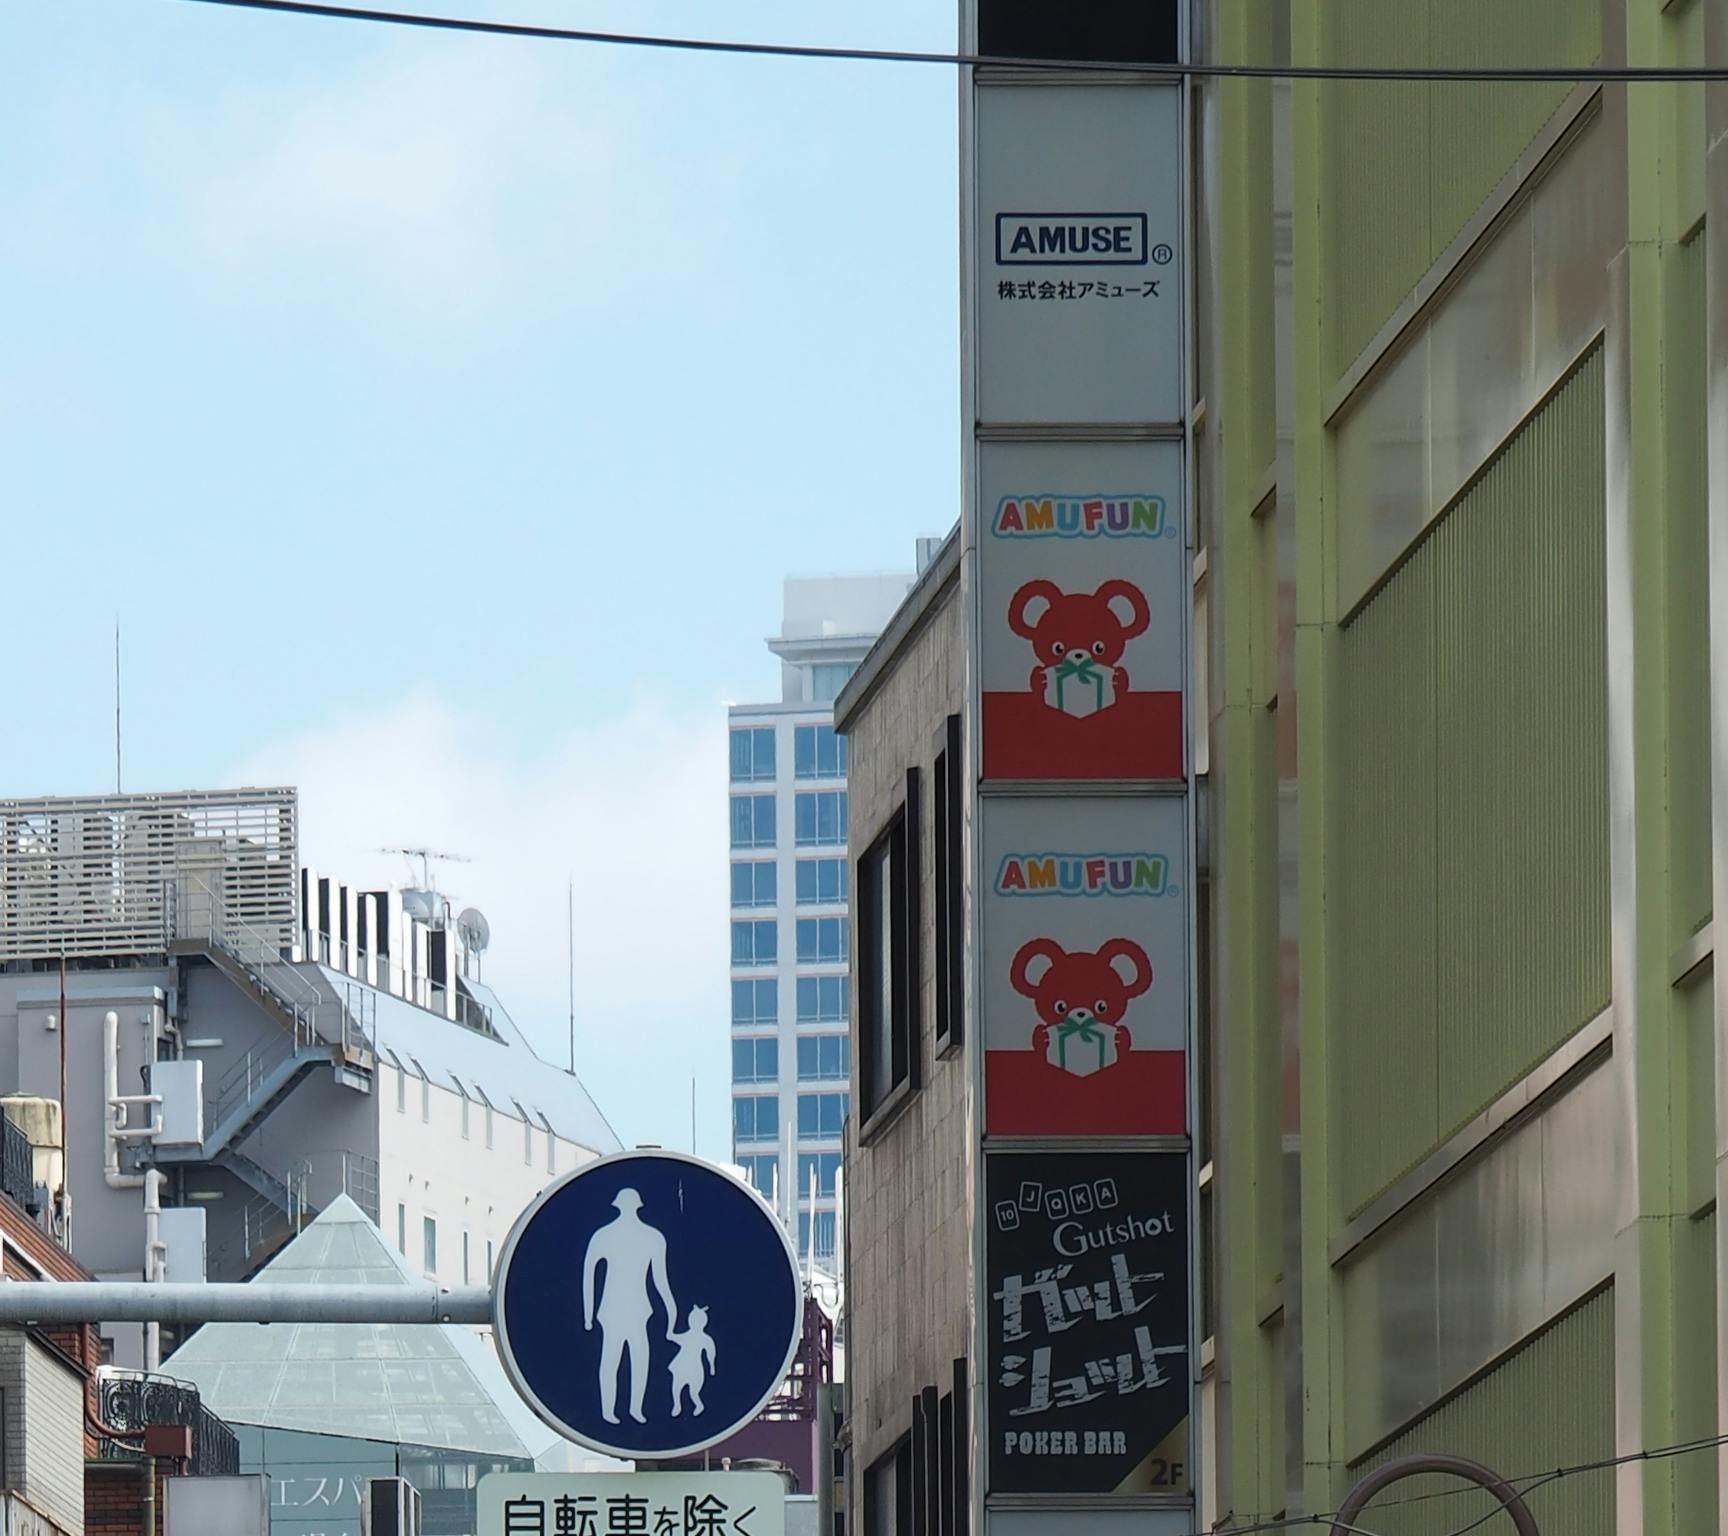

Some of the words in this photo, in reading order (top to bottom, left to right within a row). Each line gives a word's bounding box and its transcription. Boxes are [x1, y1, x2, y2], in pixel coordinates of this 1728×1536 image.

[1010, 224, 1133, 255] AMUSE
[997, 279, 1160, 300] 株式会社アミューズ
[997, 499, 1161, 535] AMUFUN
[1000, 858, 1165, 892] AMUFUN
[1052, 1211, 1175, 1258] Gutshot
[993, 1252, 1165, 1344] ガット
[997, 1324, 1187, 1417] ショット
[1004, 1431, 1079, 1455] POKER
[1083, 1431, 1127, 1455] BAR
[1150, 1458, 1184, 1488] 2F
